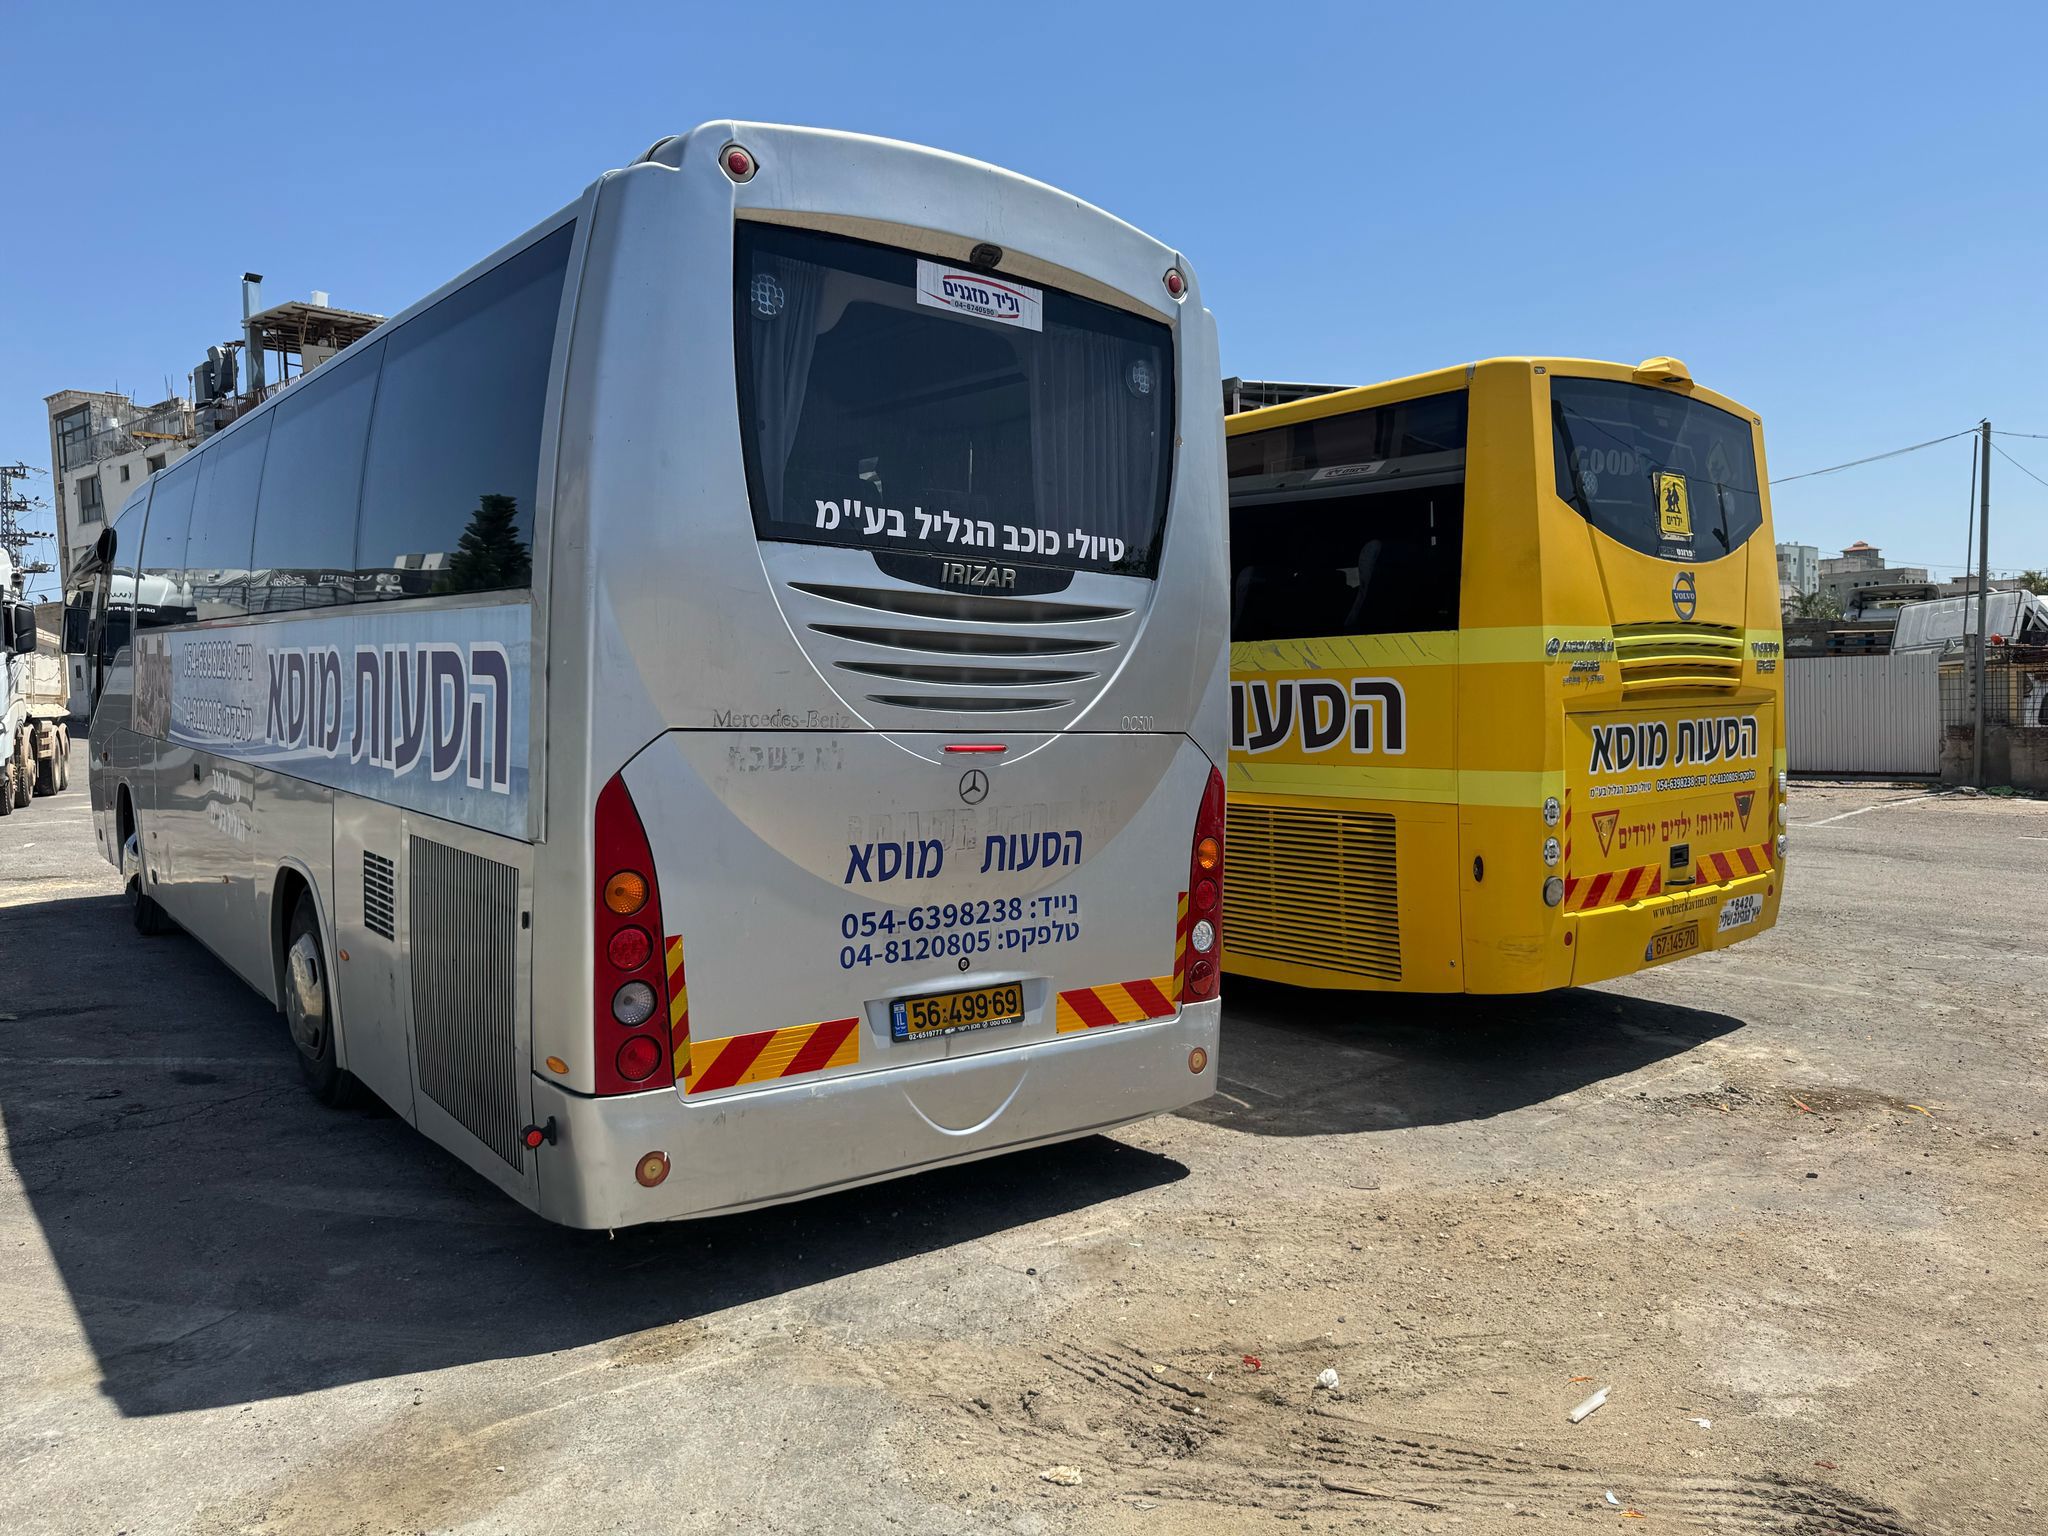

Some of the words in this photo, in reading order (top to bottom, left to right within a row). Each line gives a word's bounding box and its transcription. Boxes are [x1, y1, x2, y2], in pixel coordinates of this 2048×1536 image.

[942, 280, 990, 307] מזגנים
[992, 292, 1020, 313] וליד
[914, 506, 996, 548] הגליל
[1666, 515, 1683, 527] ילדים
[1003, 523, 1060, 556] כוכב
[1067, 528, 1125, 562] טיולי
[940, 562, 1017, 589] IRIZAR
[1673, 592, 1695, 600] VOLVO
[264, 644, 343, 760] מוסא
[350, 641, 512, 795] הסעות
[1230, 677, 1406, 755] הסעו
[1588, 720, 1669, 775] מוסא
[1674, 715, 1758, 768] הסעות
[1618, 822, 1656, 850] יורדים
[1661, 810, 1692, 842] ילדים
[1696, 810, 1735, 836] זהירות!
[844, 838, 945, 885] מוסא
[980, 829, 1083, 874] הסעות
[841, 898, 1023, 939] 054-6398238
[1029, 893, 1079, 919] נייד:
[1652, 895, 1718, 919] www.merkavim.com
[840, 930, 991, 969] 04-8120805
[997, 920, 1080, 952] טלפקס:
[896, 1013, 905, 1026] IL
